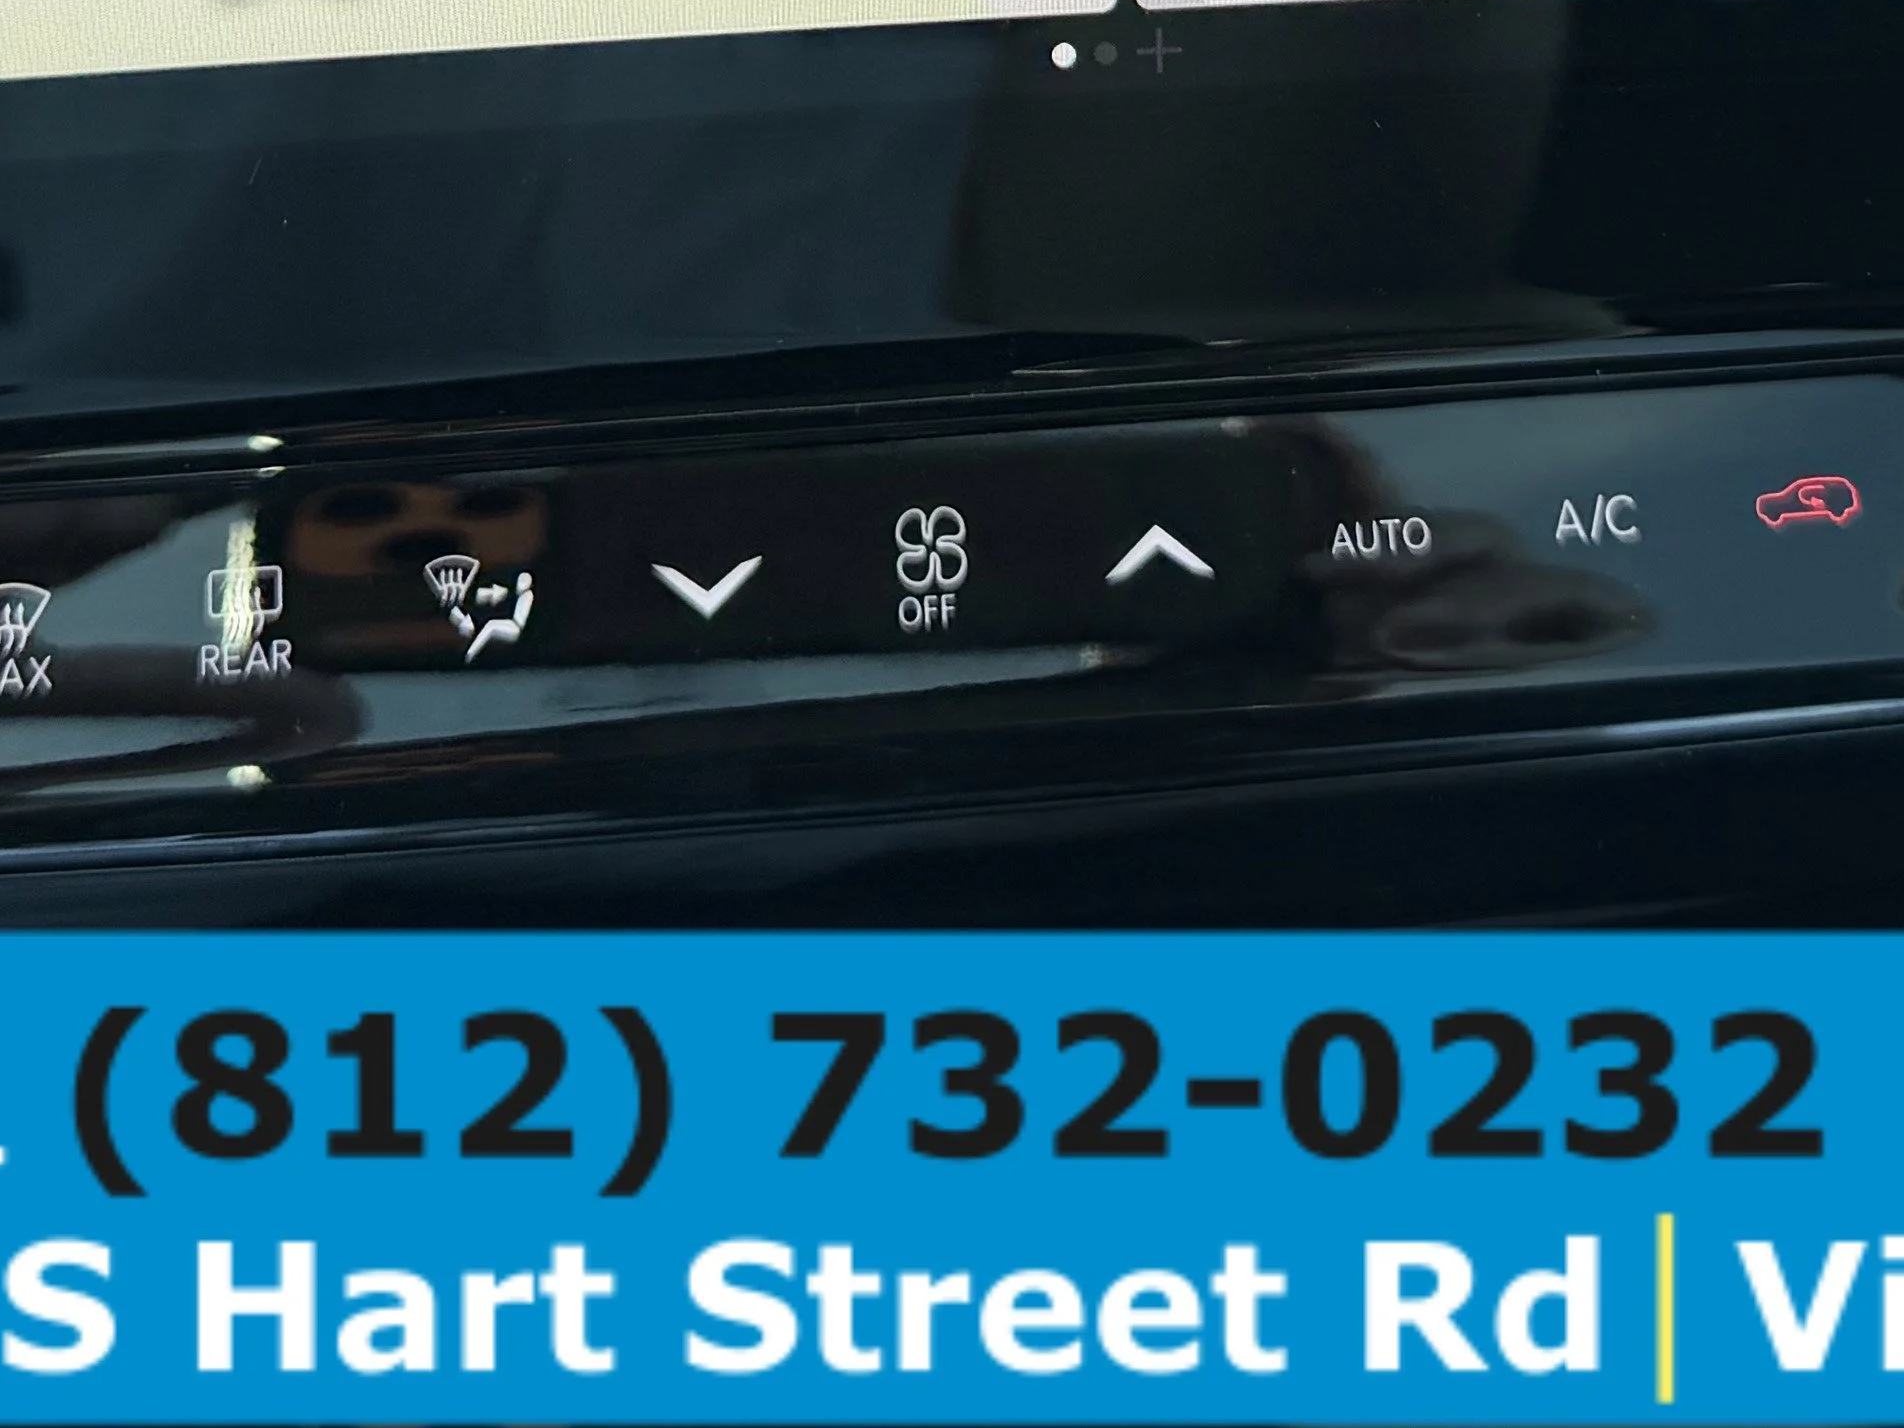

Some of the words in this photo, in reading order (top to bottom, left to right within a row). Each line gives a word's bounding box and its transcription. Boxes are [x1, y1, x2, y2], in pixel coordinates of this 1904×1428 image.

[1330, 516, 1432, 560] AUTO
[1554, 492, 1639, 546] A/C
[897, 595, 958, 631] OFF
[198, 640, 293, 680] REAR
